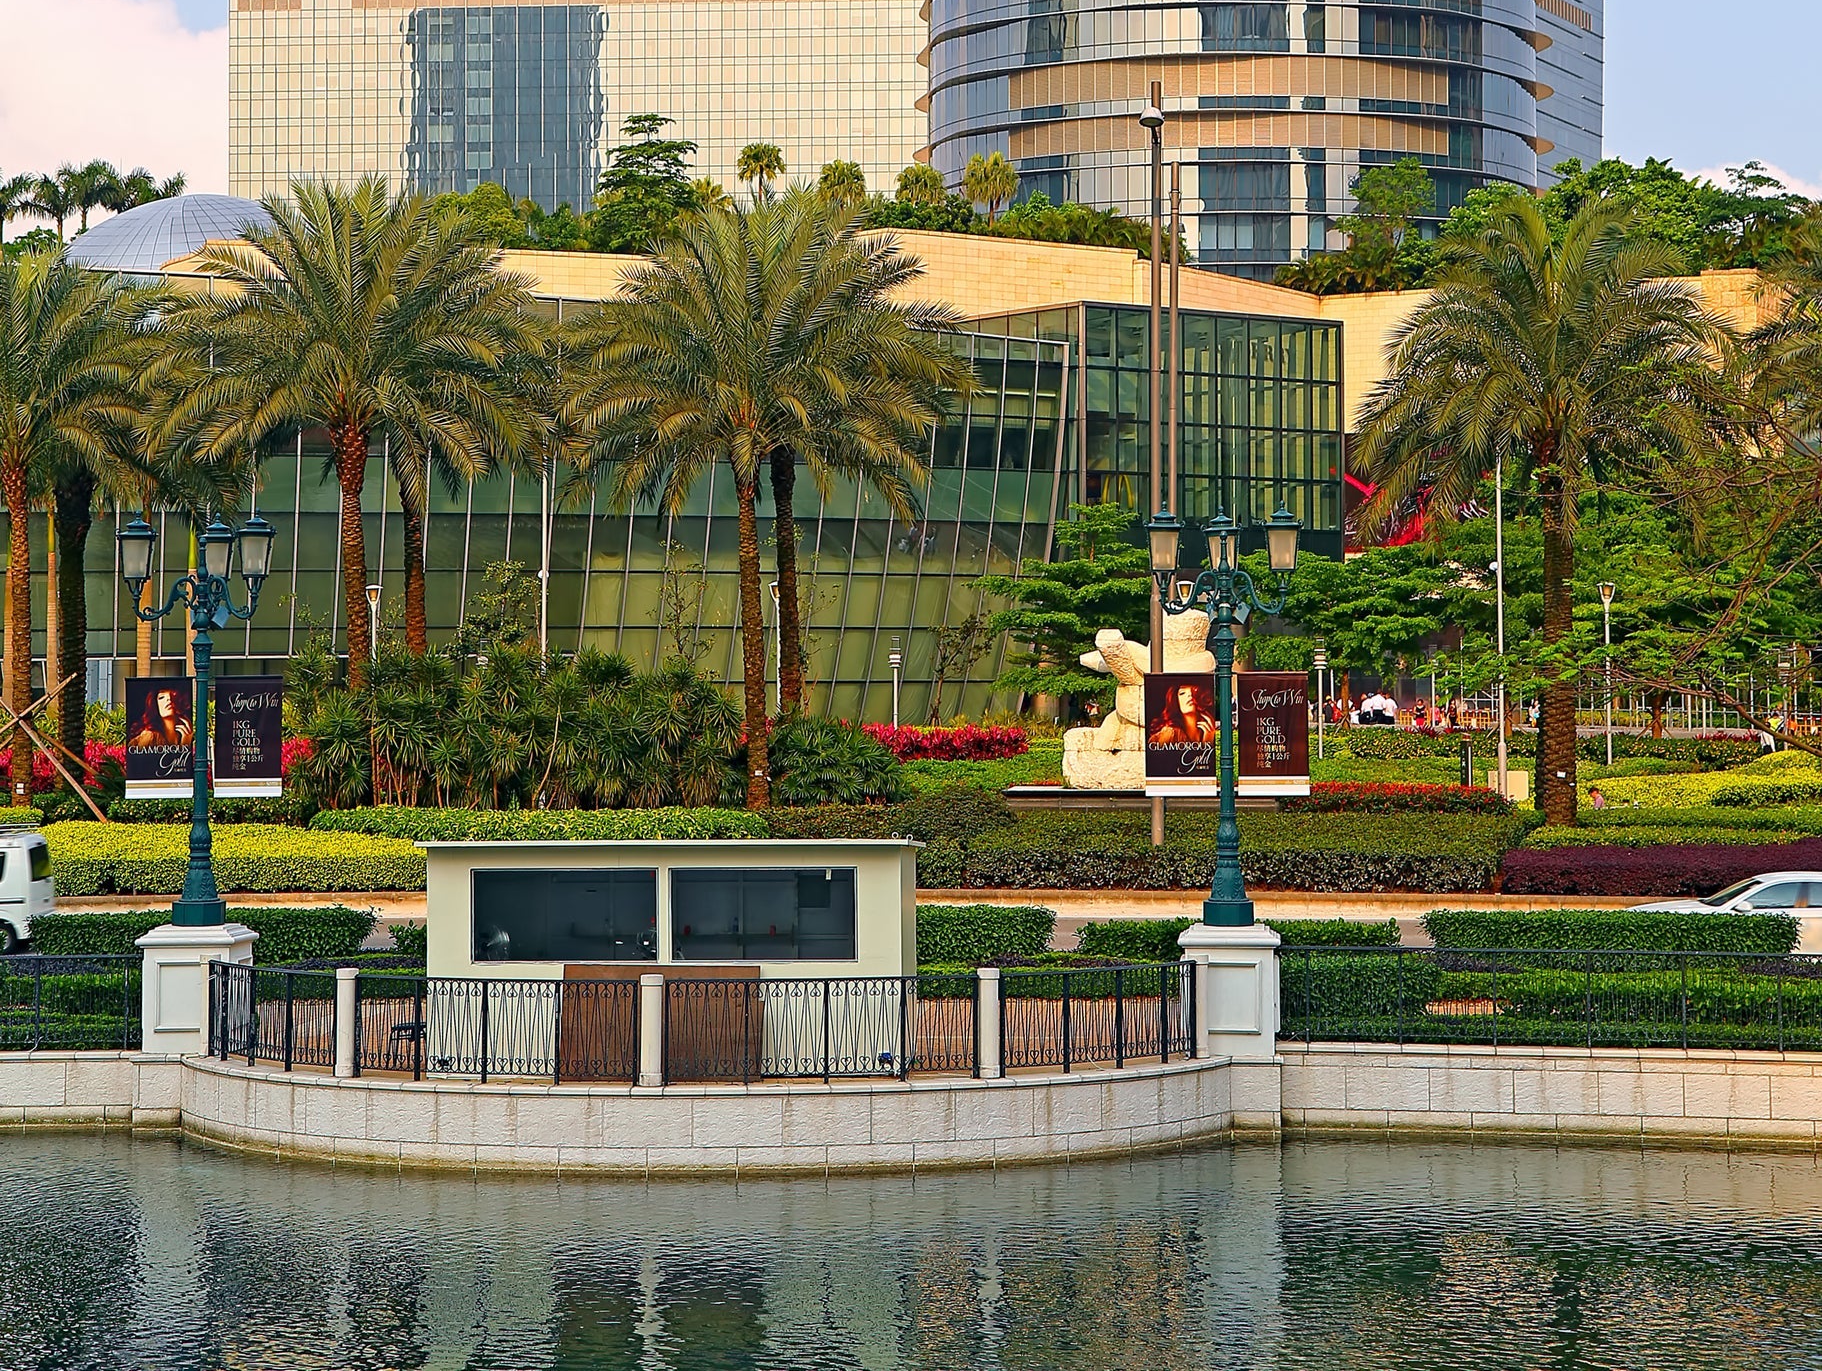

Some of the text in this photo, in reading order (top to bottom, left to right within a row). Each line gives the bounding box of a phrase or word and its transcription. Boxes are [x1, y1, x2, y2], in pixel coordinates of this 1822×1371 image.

[232, 729, 257, 738] PURE
[1256, 726, 1282, 735] PURE
[231, 738, 261, 747] GOLD
[1255, 735, 1286, 744] GOLD
[128, 744, 190, 755] GLAMOROUS
[1148, 741, 1212, 751] GLAMOROUS
